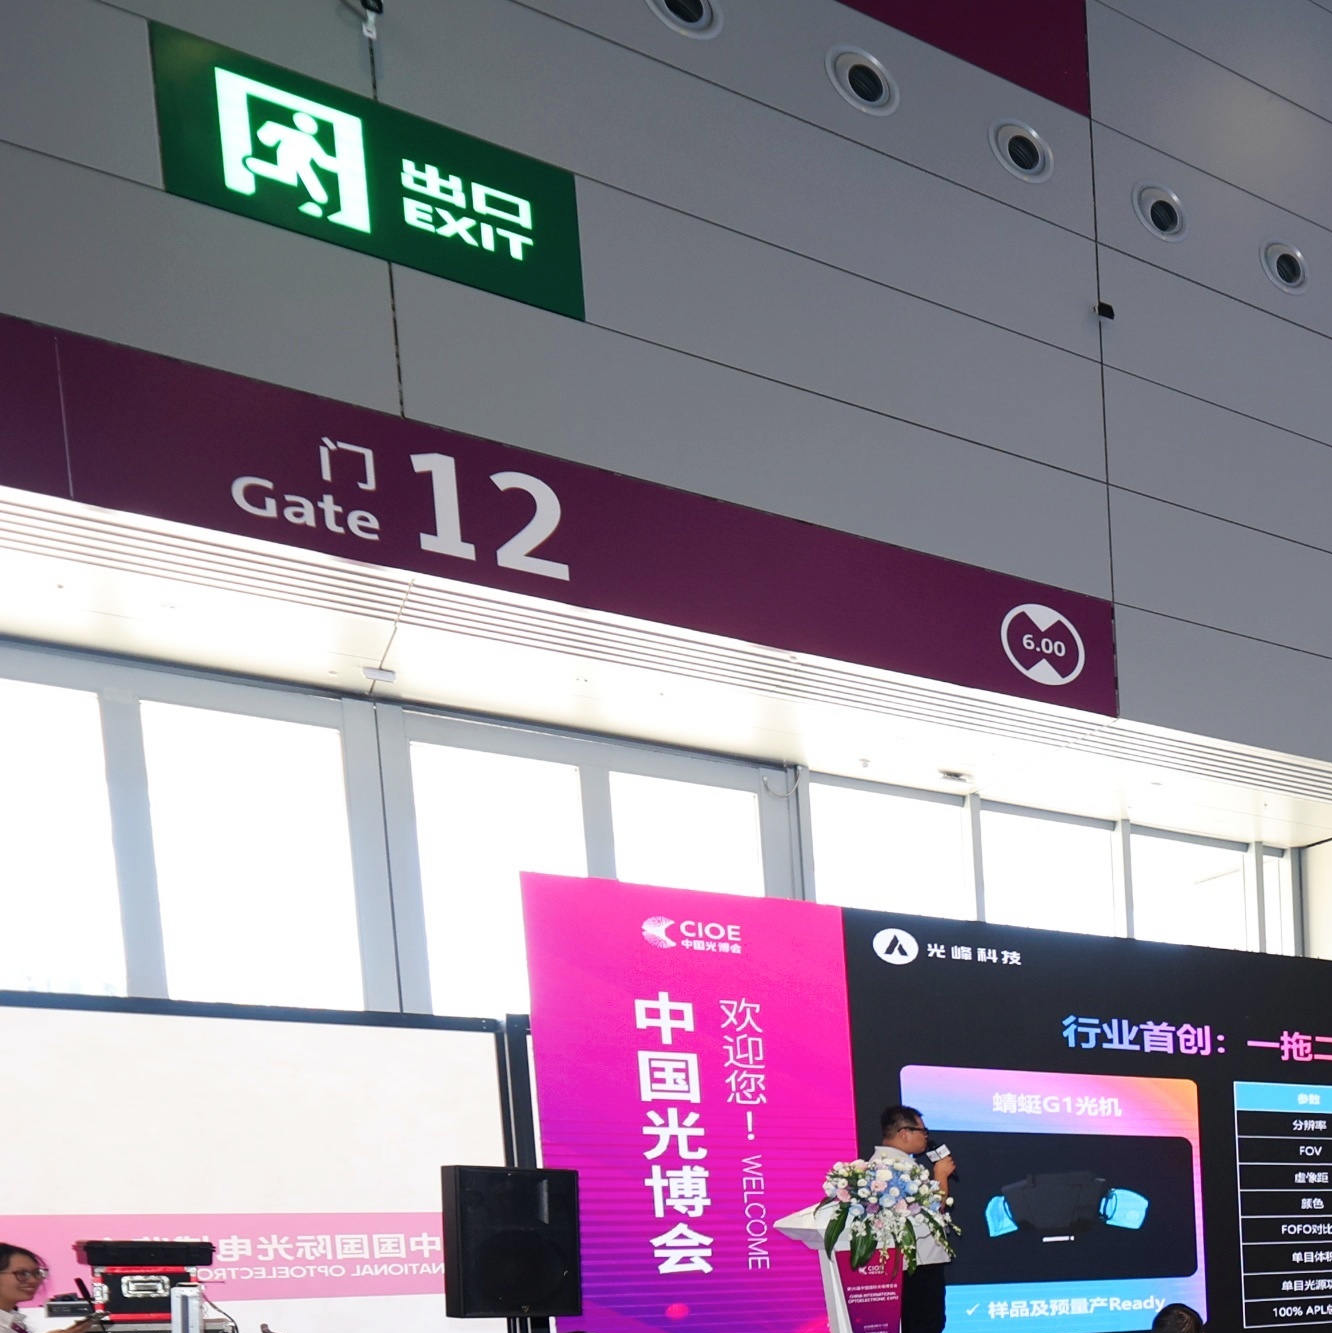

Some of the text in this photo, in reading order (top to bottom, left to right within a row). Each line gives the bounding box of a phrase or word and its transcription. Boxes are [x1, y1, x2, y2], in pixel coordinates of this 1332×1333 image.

[401, 158, 532, 230] 出口
[402, 196, 534, 261] EXIT
[319, 436, 376, 491] 门
[231, 476, 380, 541] Gate
[410, 452, 570, 581] 12
[1022, 633, 1066, 657] 6.00
[679, 920, 742, 942] CIOE
[680, 938, 742, 955] 中国光博会
[926, 942, 1023, 966] 光峰科技
[992, 1092, 1123, 1118] 蜻蜓G1光机
[634, 991, 714, 1275] 中国光博会
[719, 997, 770, 1271] 欢迎您！ WELCOME
[1292, 1119, 1327, 1131] 分辨率
[1299, 1146, 1323, 1156] FOV
[1294, 1172, 1329, 1184] 虚像距
[1301, 1198, 1325, 1210] 颜色
[987, 1295, 1166, 1320] 样品及预量产Ready
[1272, 1305, 1304, 1318] 100%
